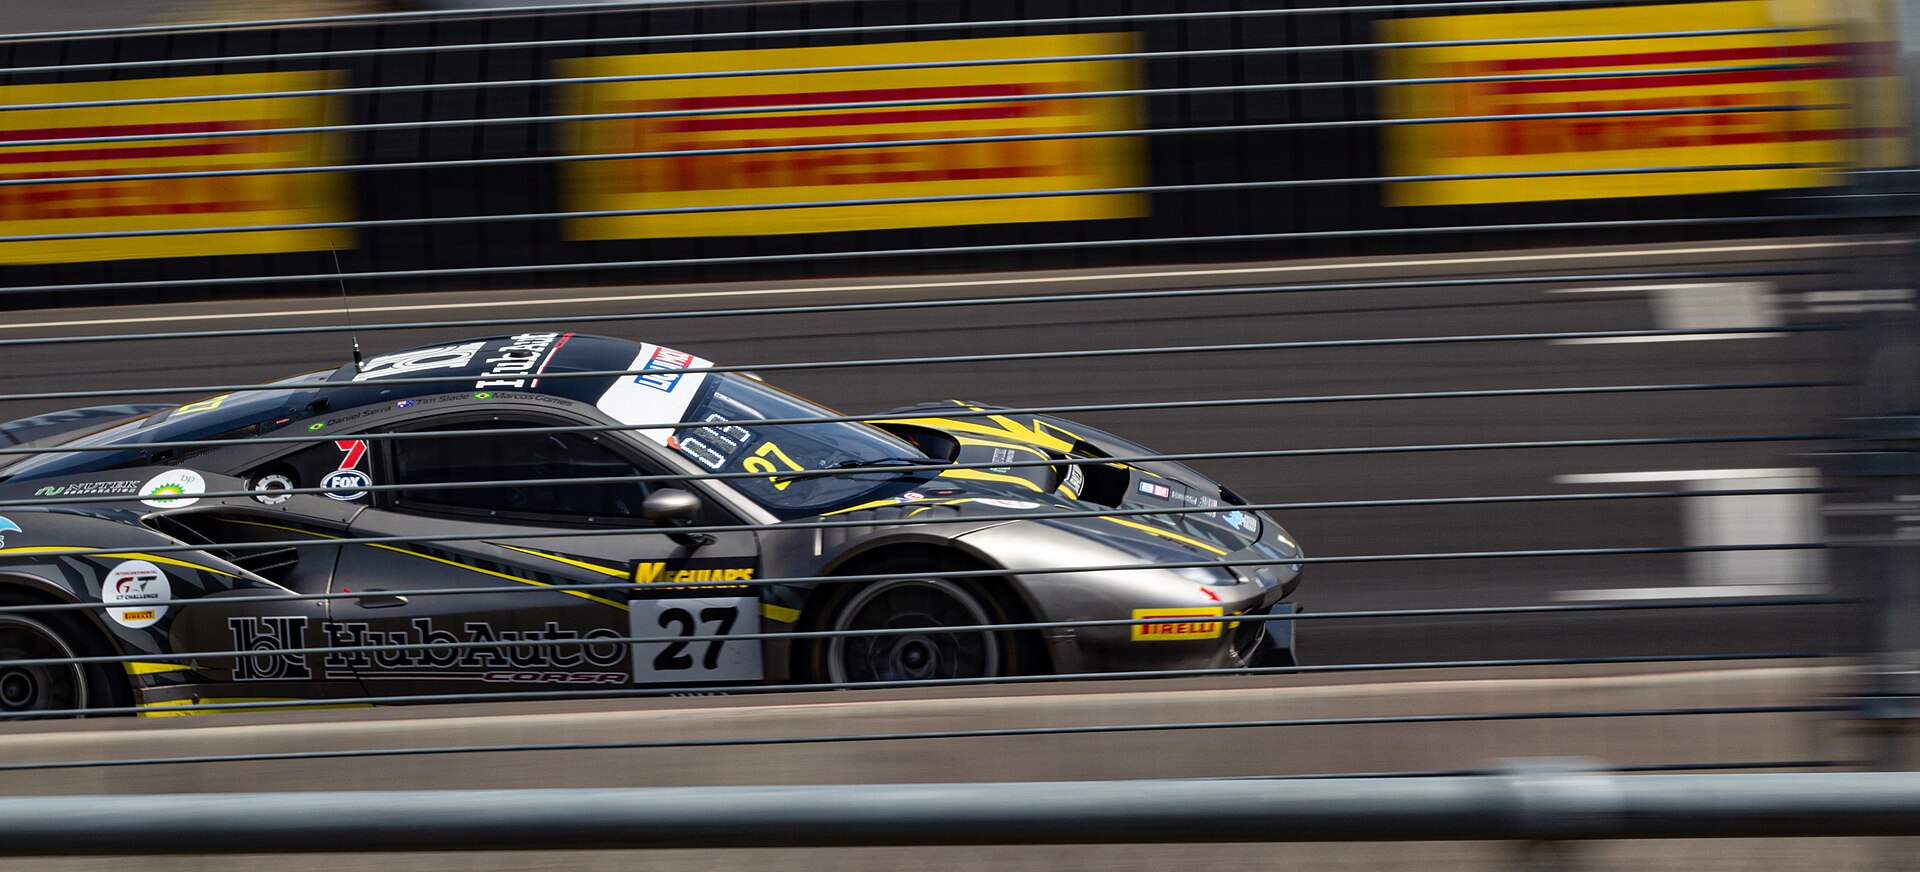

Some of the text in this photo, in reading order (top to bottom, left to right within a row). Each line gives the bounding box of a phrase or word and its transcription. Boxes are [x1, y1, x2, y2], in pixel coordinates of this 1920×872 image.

[475, 332, 559, 389] HubAut
[416, 393, 470, 406] Tim Slade
[491, 392, 574, 407] Marcos Gomes
[326, 406, 392, 427] Daniel Serra
[742, 441, 805, 491] 27
[65, 480, 141, 491] NUTEK
[180, 474, 196, 484] bp
[331, 476, 360, 489] FOX
[1141, 614, 1215, 635] PIRELLI
[322, 617, 627, 669] HubAuto
[652, 606, 739, 671] 27
[482, 670, 629, 684] CORSA
